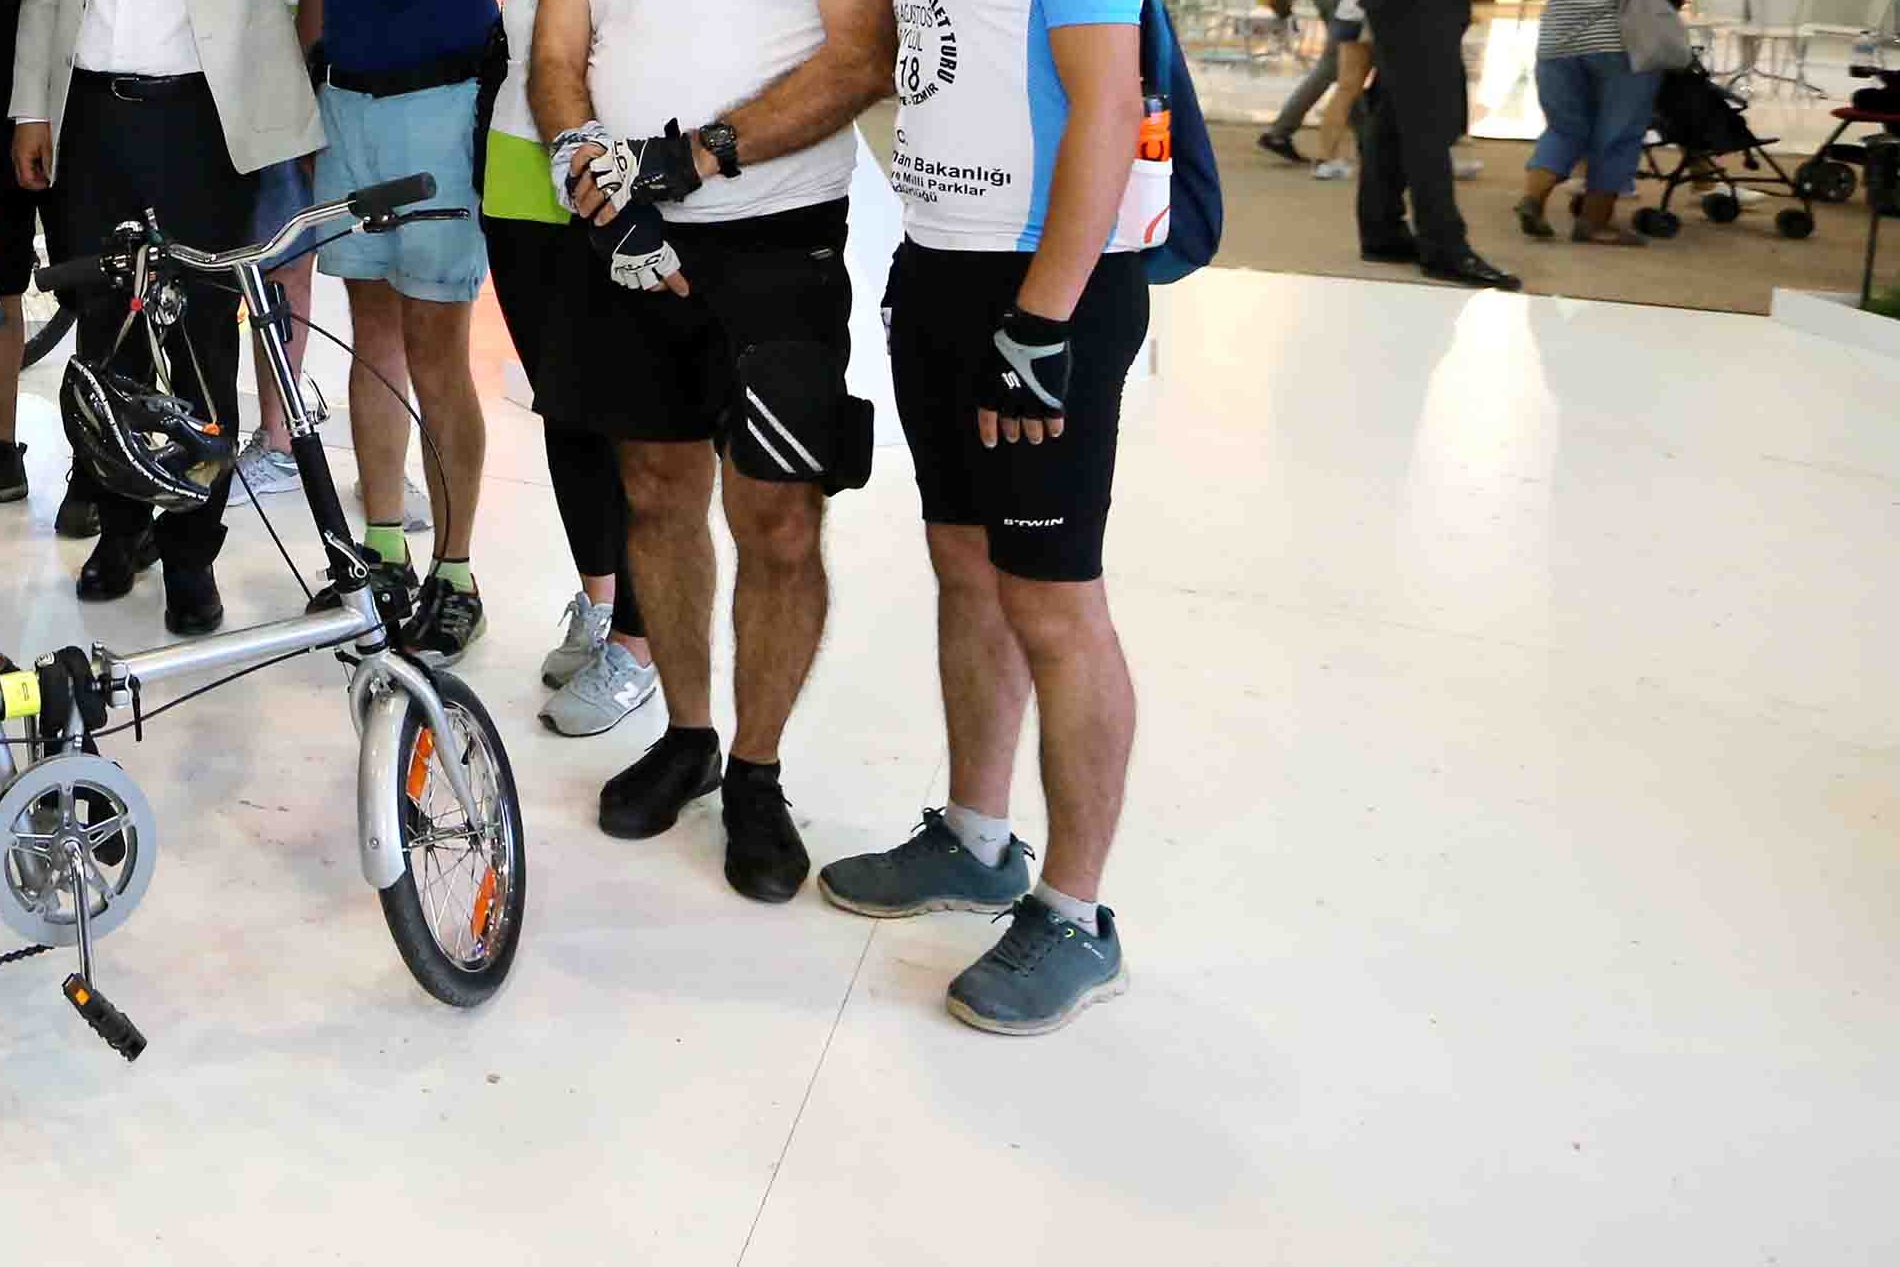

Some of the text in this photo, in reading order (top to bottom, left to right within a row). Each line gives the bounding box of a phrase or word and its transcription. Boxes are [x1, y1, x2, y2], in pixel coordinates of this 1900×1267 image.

[937, 32, 957, 84] TURU
[914, 157, 1011, 187] Bakanlığı
[928, 179, 987, 196] Parklar
